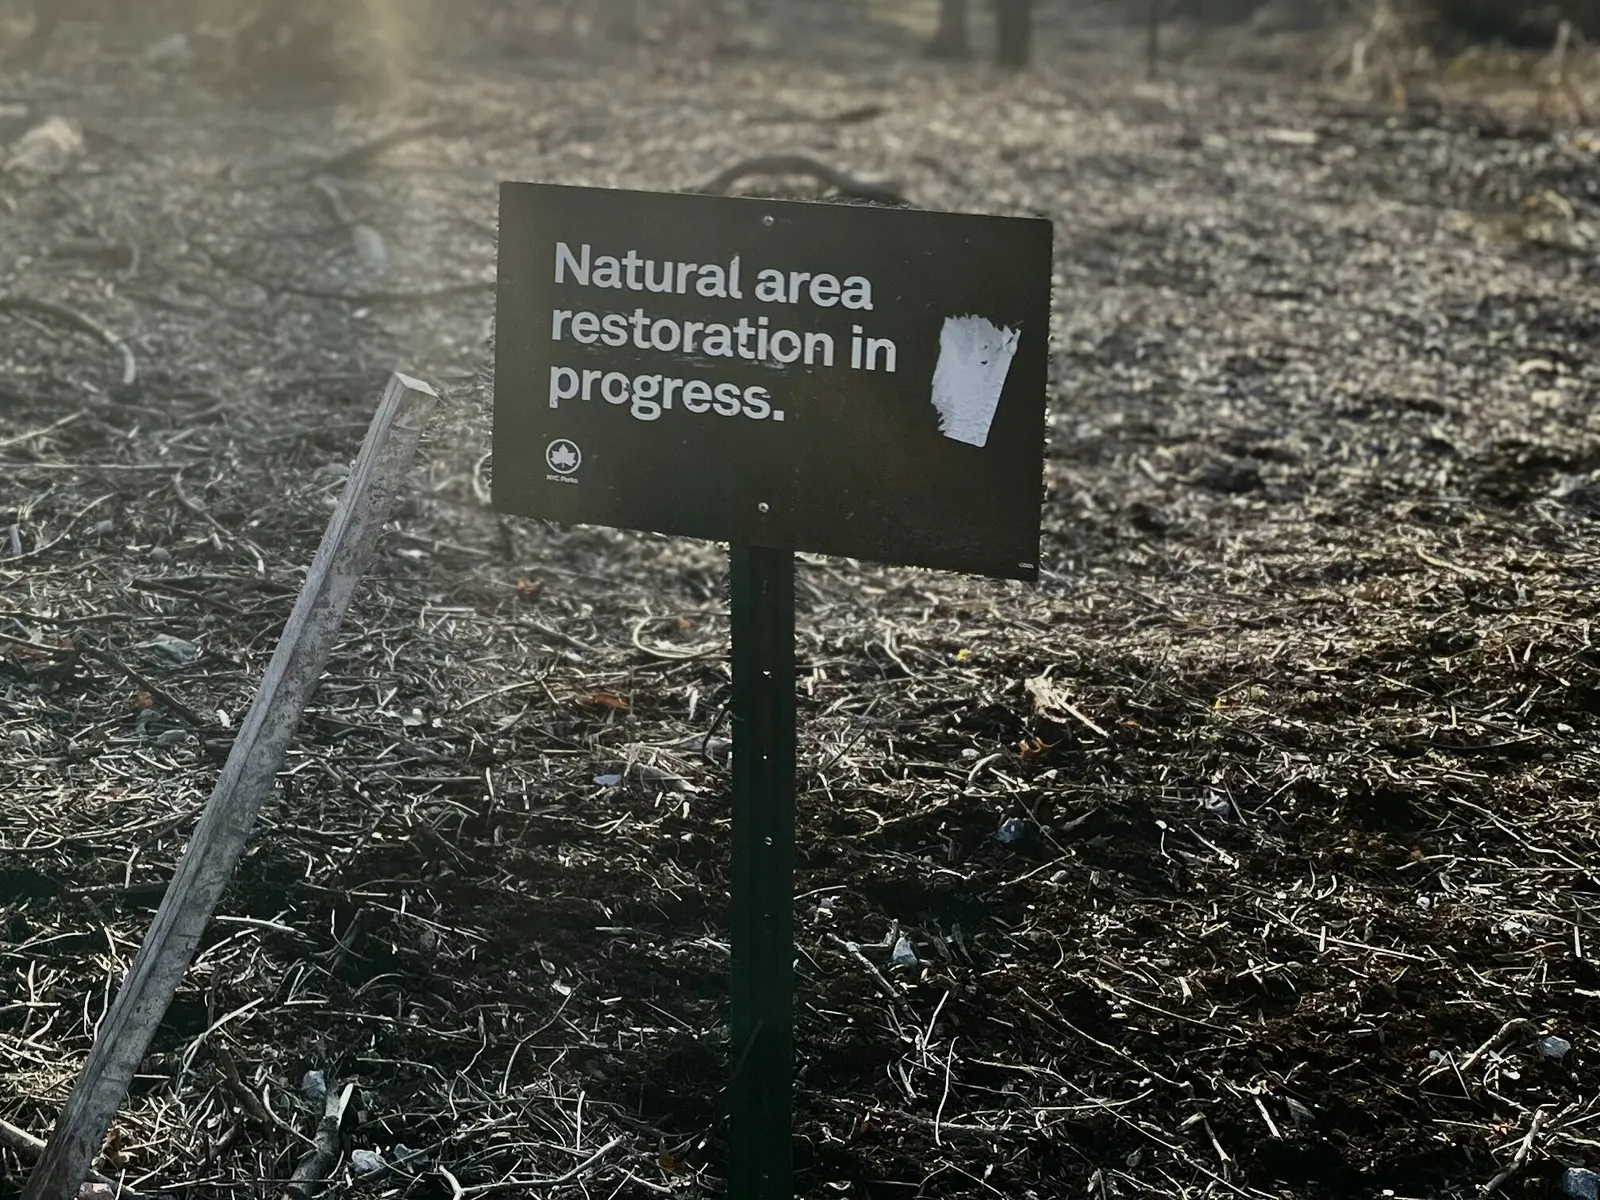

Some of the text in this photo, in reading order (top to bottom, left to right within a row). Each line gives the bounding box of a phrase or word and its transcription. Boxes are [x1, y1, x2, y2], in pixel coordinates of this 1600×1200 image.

[554, 242, 874, 311] Natural area
[552, 308, 897, 373] restoration in
[549, 366, 786, 421] progress.
